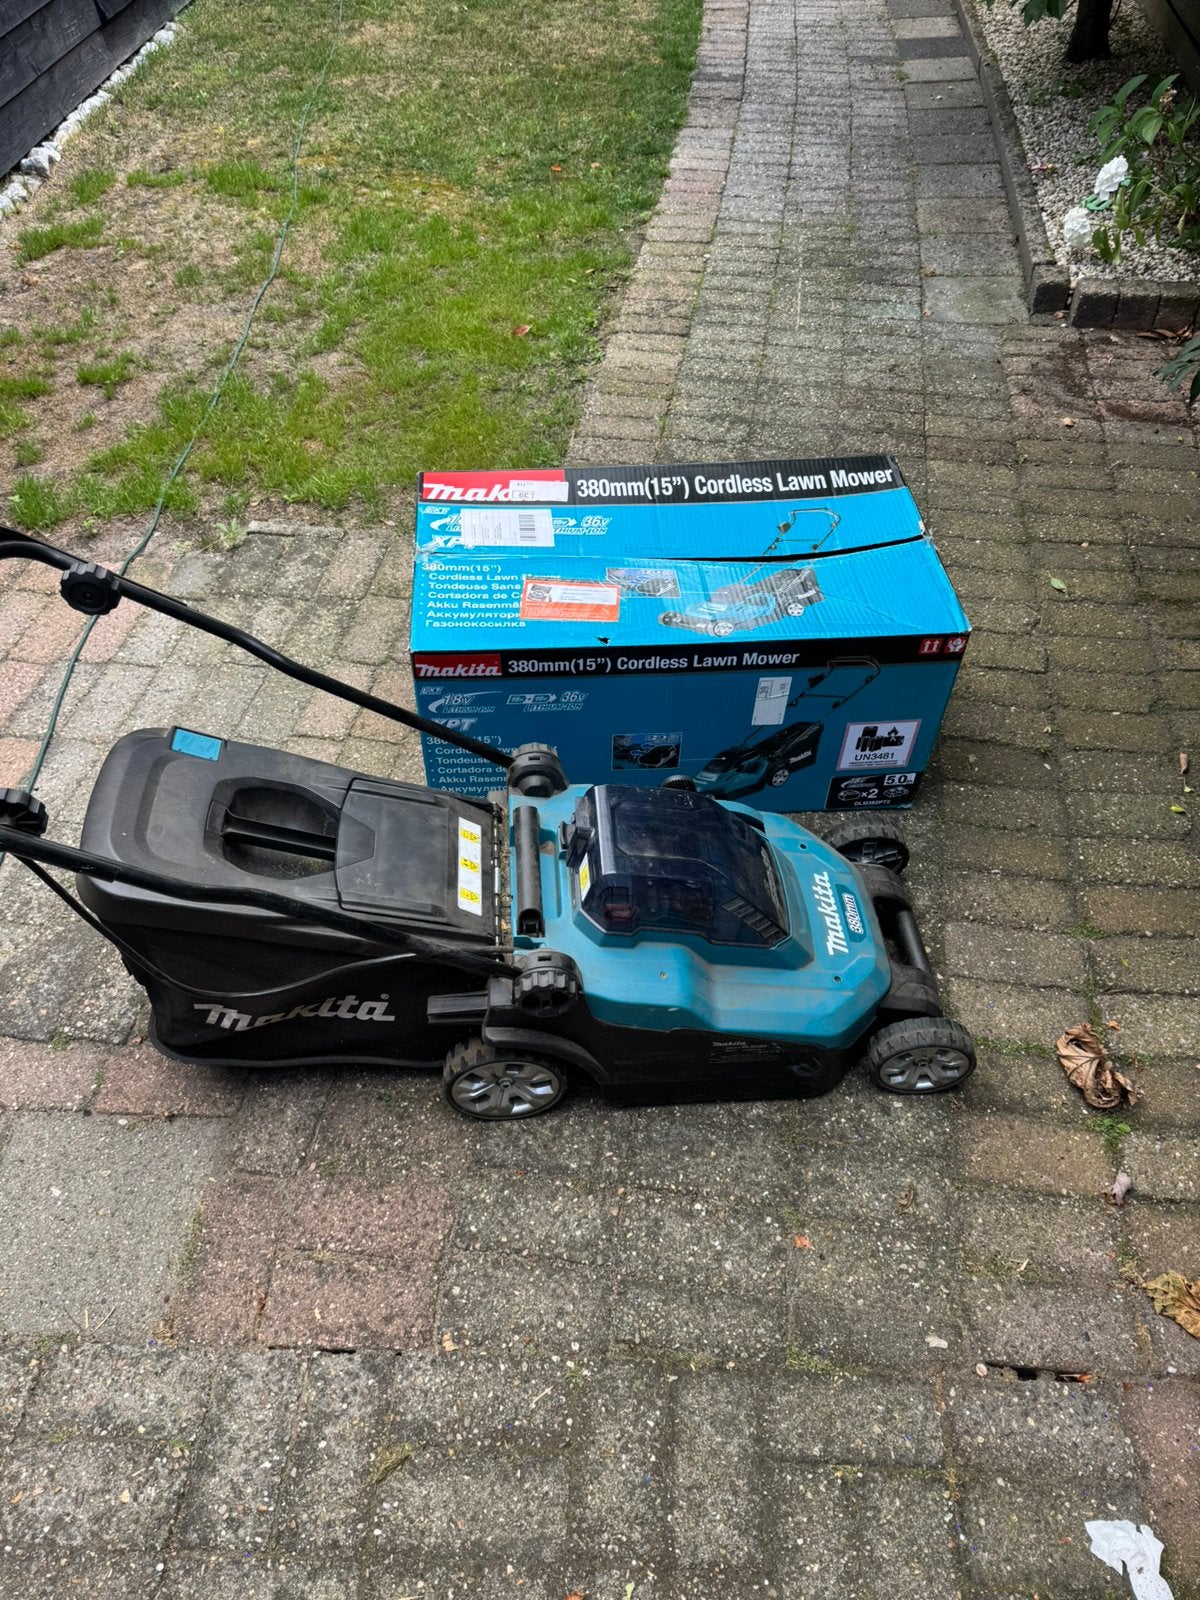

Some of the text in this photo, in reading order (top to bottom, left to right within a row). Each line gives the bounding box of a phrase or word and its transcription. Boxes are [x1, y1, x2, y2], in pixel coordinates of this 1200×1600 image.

[694, 473, 774, 495] Cordless
[776, 471, 828, 492] Lawn
[829, 467, 893, 488] Mower
[428, 573, 483, 581] Cordless
[486, 573, 519, 581] Lawn
[428, 581, 488, 590] Tondeuse
[427, 591, 489, 599] Cortadora
[492, 591, 508, 599] de
[427, 600, 521, 609] Akku Rasenmä
[425, 619, 527, 628] Газонокосилка
[616, 655, 689, 670] Cordless
[692, 654, 739, 668] Lawn
[742, 652, 800, 666] Mower
[854, 752, 895, 761] UN3481
[437, 766, 493, 774] Cortadora
[439, 775, 466, 784] Akku
[842, 893, 863, 934] 380mm
